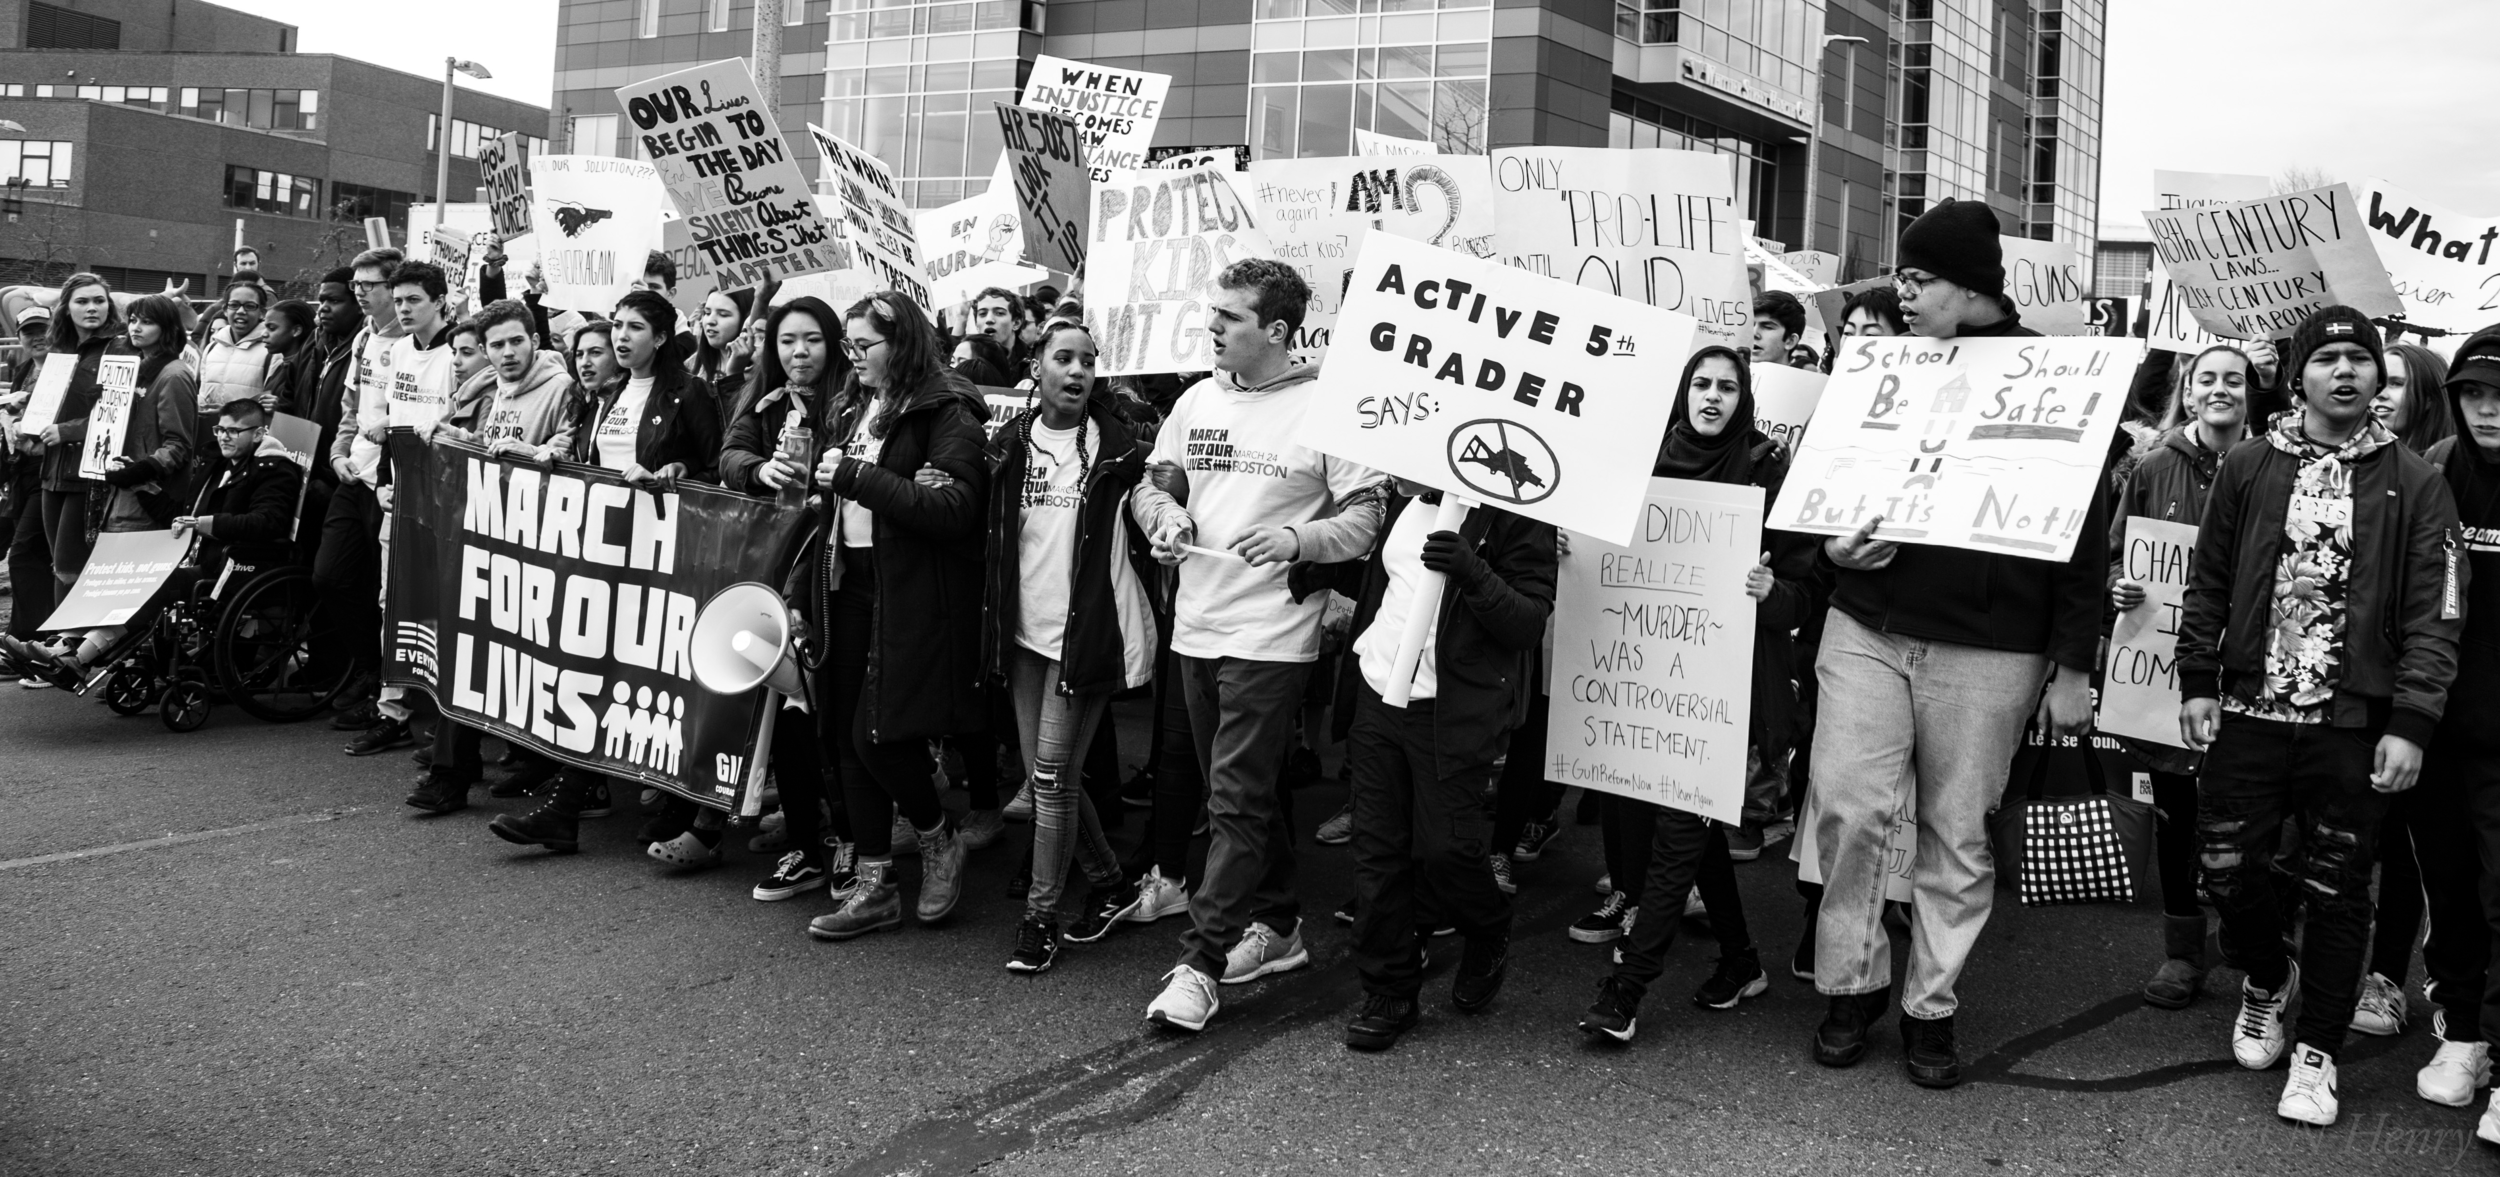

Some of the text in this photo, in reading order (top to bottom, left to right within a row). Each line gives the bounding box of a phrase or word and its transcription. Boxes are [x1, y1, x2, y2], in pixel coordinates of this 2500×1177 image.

[1062, 67, 1142, 96] WHEN
[629, 80, 749, 130] OUR Lives
[1032, 85, 1158, 119] INJUSTICE
[726, 110, 765, 140] TO
[1027, 113, 1079, 167] 5087
[479, 142, 505, 177] HOW
[686, 148, 742, 178] THE
[738, 137, 784, 171] DAY
[812, 131, 848, 171] THE
[1083, 145, 1141, 170] TANCE
[485, 164, 519, 204] MANY
[552, 160, 655, 180] OUR SOLUTION???
[1014, 152, 1052, 212] LOOK
[1088, 167, 1112, 183] ES
[1499, 156, 1563, 192] ONLY
[668, 173, 784, 215] WE Become
[1257, 182, 1325, 203] #never
[490, 194, 529, 235] MORE?
[757, 199, 811, 227] About
[1034, 191, 1061, 243] IT
[1277, 206, 1318, 233] again
[2148, 190, 2341, 268] 18th CENTURY
[2369, 190, 2499, 266] What
[697, 220, 828, 266] THINGS That
[1268, 238, 1308, 258] rotect
[548, 250, 616, 286] #NEVERAGAIN
[716, 249, 823, 292] MATTER
[2014, 258, 2080, 307] GUNS
[2210, 257, 2280, 281] LAWS...
[1376, 263, 1560, 346] ACTIVE
[2217, 270, 2326, 311] CENTURY
[2388, 272, 2455, 306] sier
[1085, 302, 1162, 372] NOT
[101, 364, 134, 387] CAUTION
[1369, 321, 1585, 418] GRADER
[1846, 339, 2110, 380] School Should
[98, 388, 130, 407] STUDENTS
[370, 380, 388, 390] BOST
[417, 395, 446, 405] BOSTON
[1866, 374, 1909, 419] Be
[97, 406, 118, 424] DYING
[1356, 391, 1440, 430] SAYS:
[599, 426, 607, 435] ES
[1189, 428, 1228, 442] MARCH
[1187, 443, 1278, 462] FOR OUR MARCH 24
[1187, 458, 1288, 479] LIVES BOSTON
[463, 457, 679, 575] MARCH
[1045, 495, 1080, 509] BOST
[1796, 488, 1935, 525] But It's
[1646, 503, 1740, 548] DIDN'T
[84, 561, 173, 576] Protect kids, not guns.
[232, 563, 256, 573] drive
[1600, 552, 1706, 588] REALIZE
[459, 544, 697, 682] FOR OUR
[1591, 638, 1684, 679] WAS A
[2111, 645, 2182, 692] COM
[452, 632, 604, 754] LIVES
[1572, 674, 1734, 726] CONTROVERSIAL
[1584, 715, 1710, 765] STATEMENT.
[1657, 774, 1714, 808] #NeverAgain
